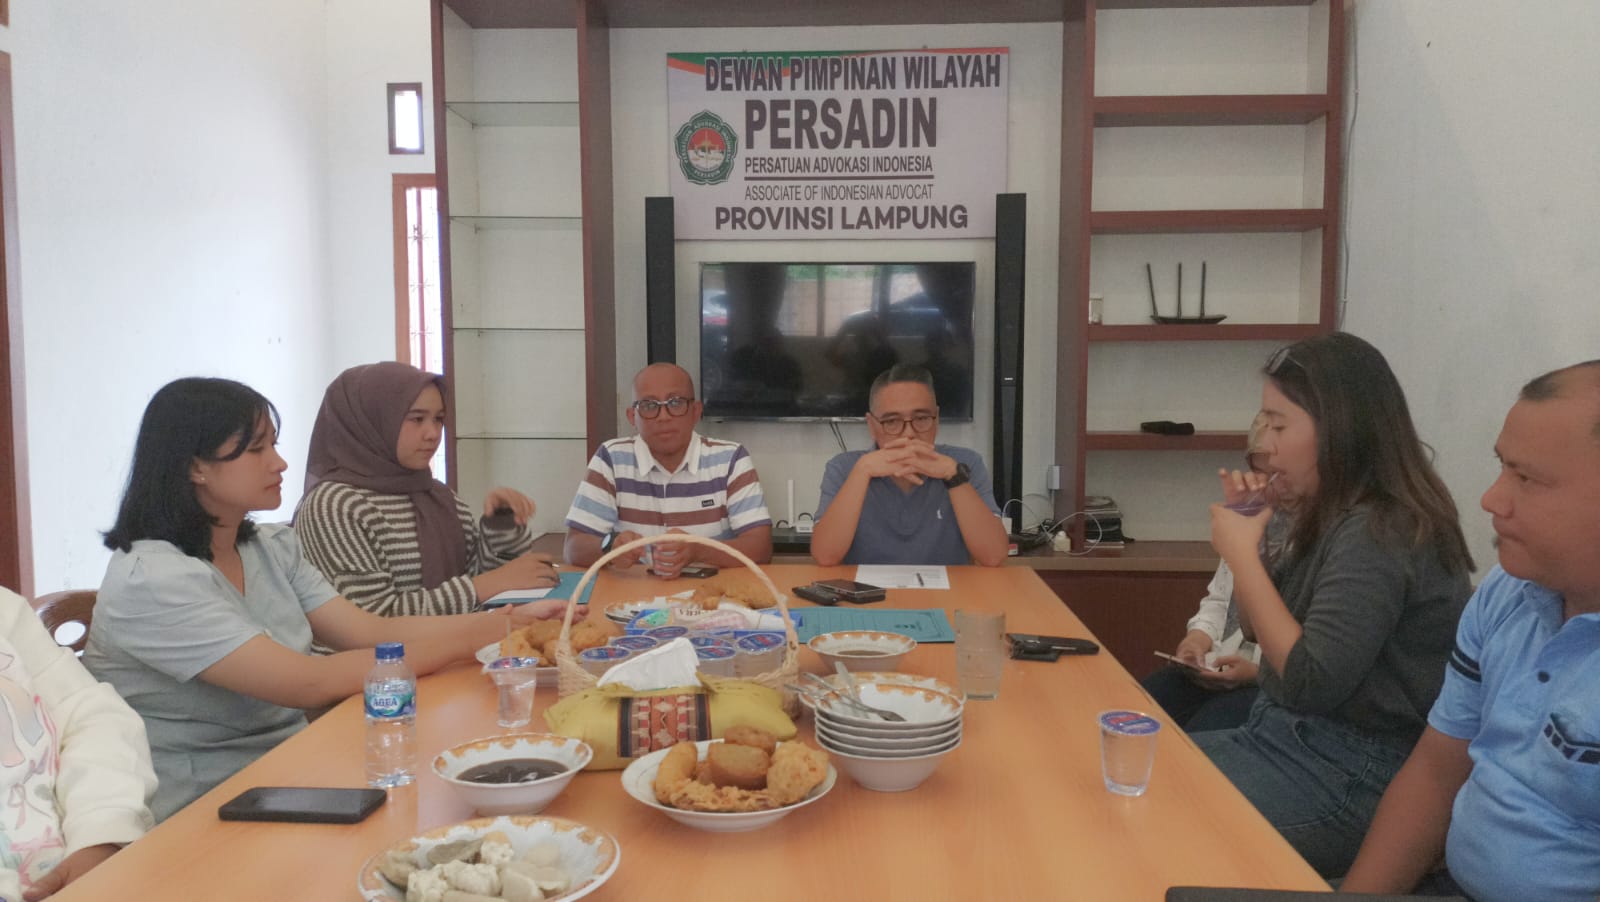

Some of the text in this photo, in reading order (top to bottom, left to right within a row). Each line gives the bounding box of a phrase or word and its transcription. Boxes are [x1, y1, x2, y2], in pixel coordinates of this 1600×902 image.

[705, 54, 1000, 91] DEWAN PIMPINAN WILAYAH
[745, 97, 937, 150] PERSADIN
[745, 155, 933, 173] PERSATUAN ADVOKASI INDONESIA
[745, 184, 934, 201] ASSOCIATE OF INDONESIAN ADVOCAT
[715, 205, 968, 230] PROVINSI LAMPUNG
